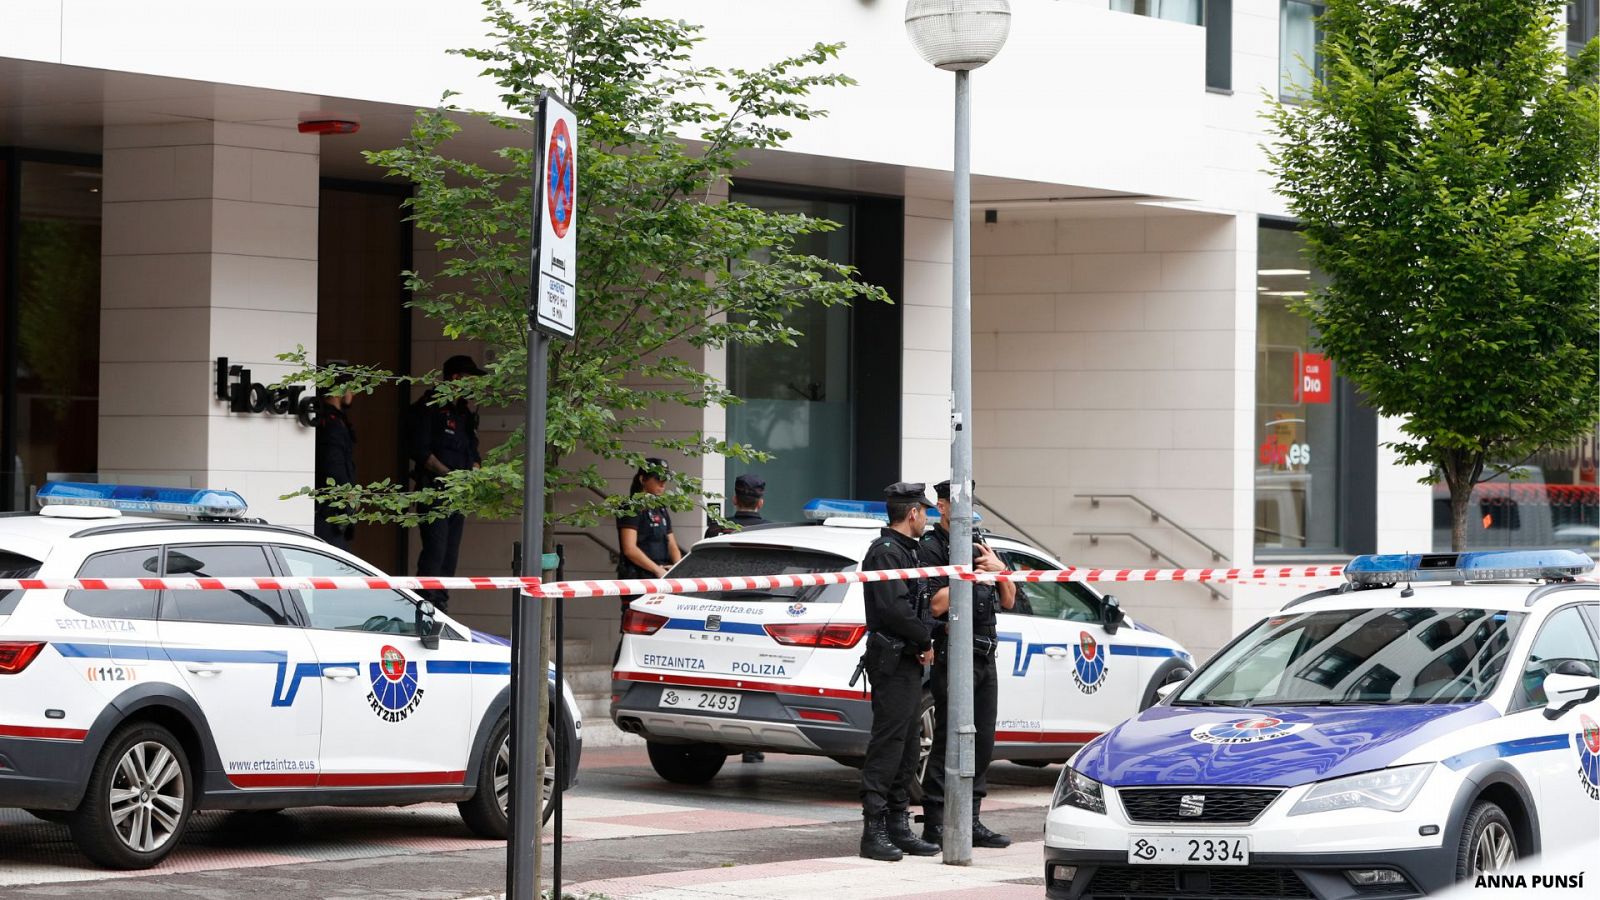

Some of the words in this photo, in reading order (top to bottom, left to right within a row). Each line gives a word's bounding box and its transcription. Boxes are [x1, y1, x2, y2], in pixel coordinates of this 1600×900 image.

[676, 602, 764, 617] www.ertzaintza.eus
[55, 618, 137, 633] ERTZAINTZA
[689, 632, 735, 643] LEON
[643, 654, 706, 671] ERTZAINTZA
[732, 662, 786, 677] POLIZIA
[1072, 667, 1109, 695] ERTZAINTZA
[366, 687, 425, 724] ERTZAINTZA
[697, 692, 738, 712] 2493
[228, 757, 316, 771] www.ertzaintza.eus
[1188, 839, 1244, 861] 2334
